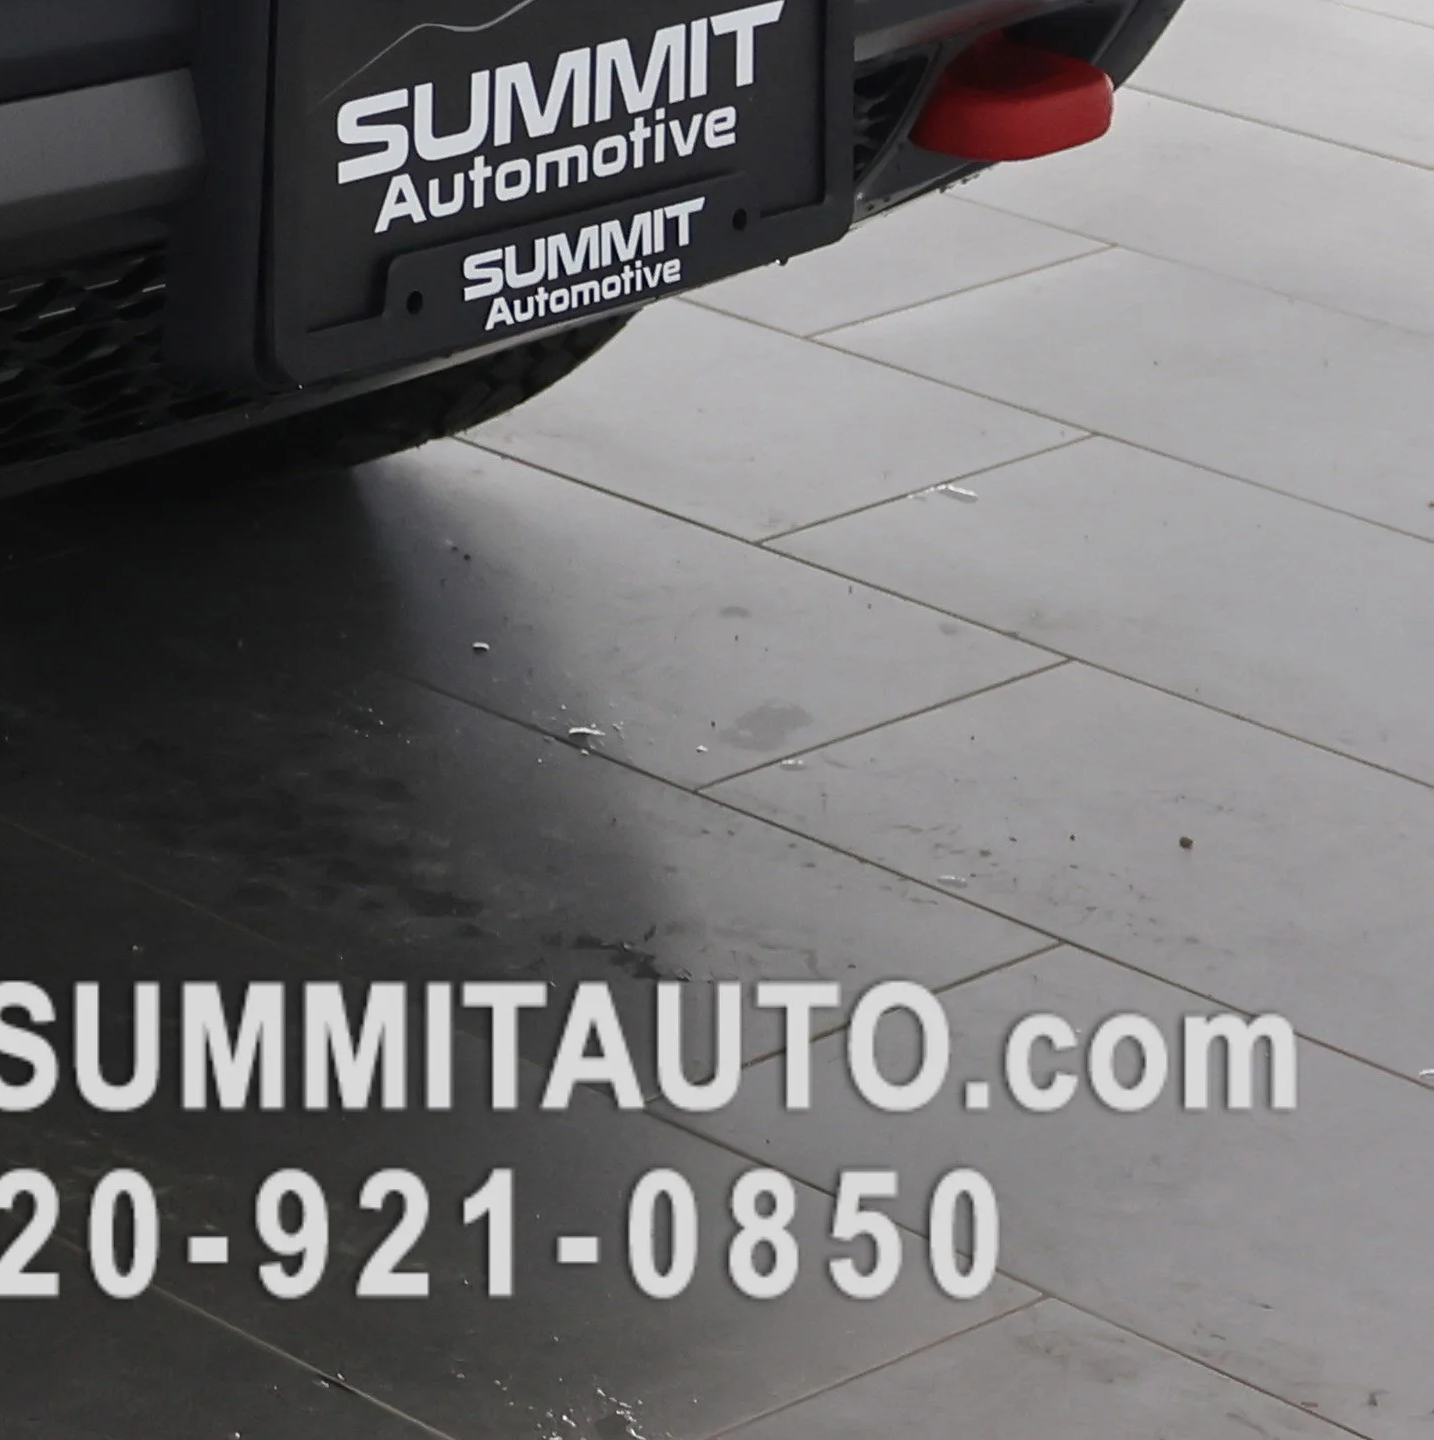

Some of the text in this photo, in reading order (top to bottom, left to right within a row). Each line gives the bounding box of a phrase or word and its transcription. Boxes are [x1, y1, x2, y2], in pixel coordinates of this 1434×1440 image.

[337, 0, 785, 184] SUMMIT
[374, 103, 736, 233] Automotive
[462, 196, 705, 301] SUMMIT
[484, 257, 681, 331] Automotive
